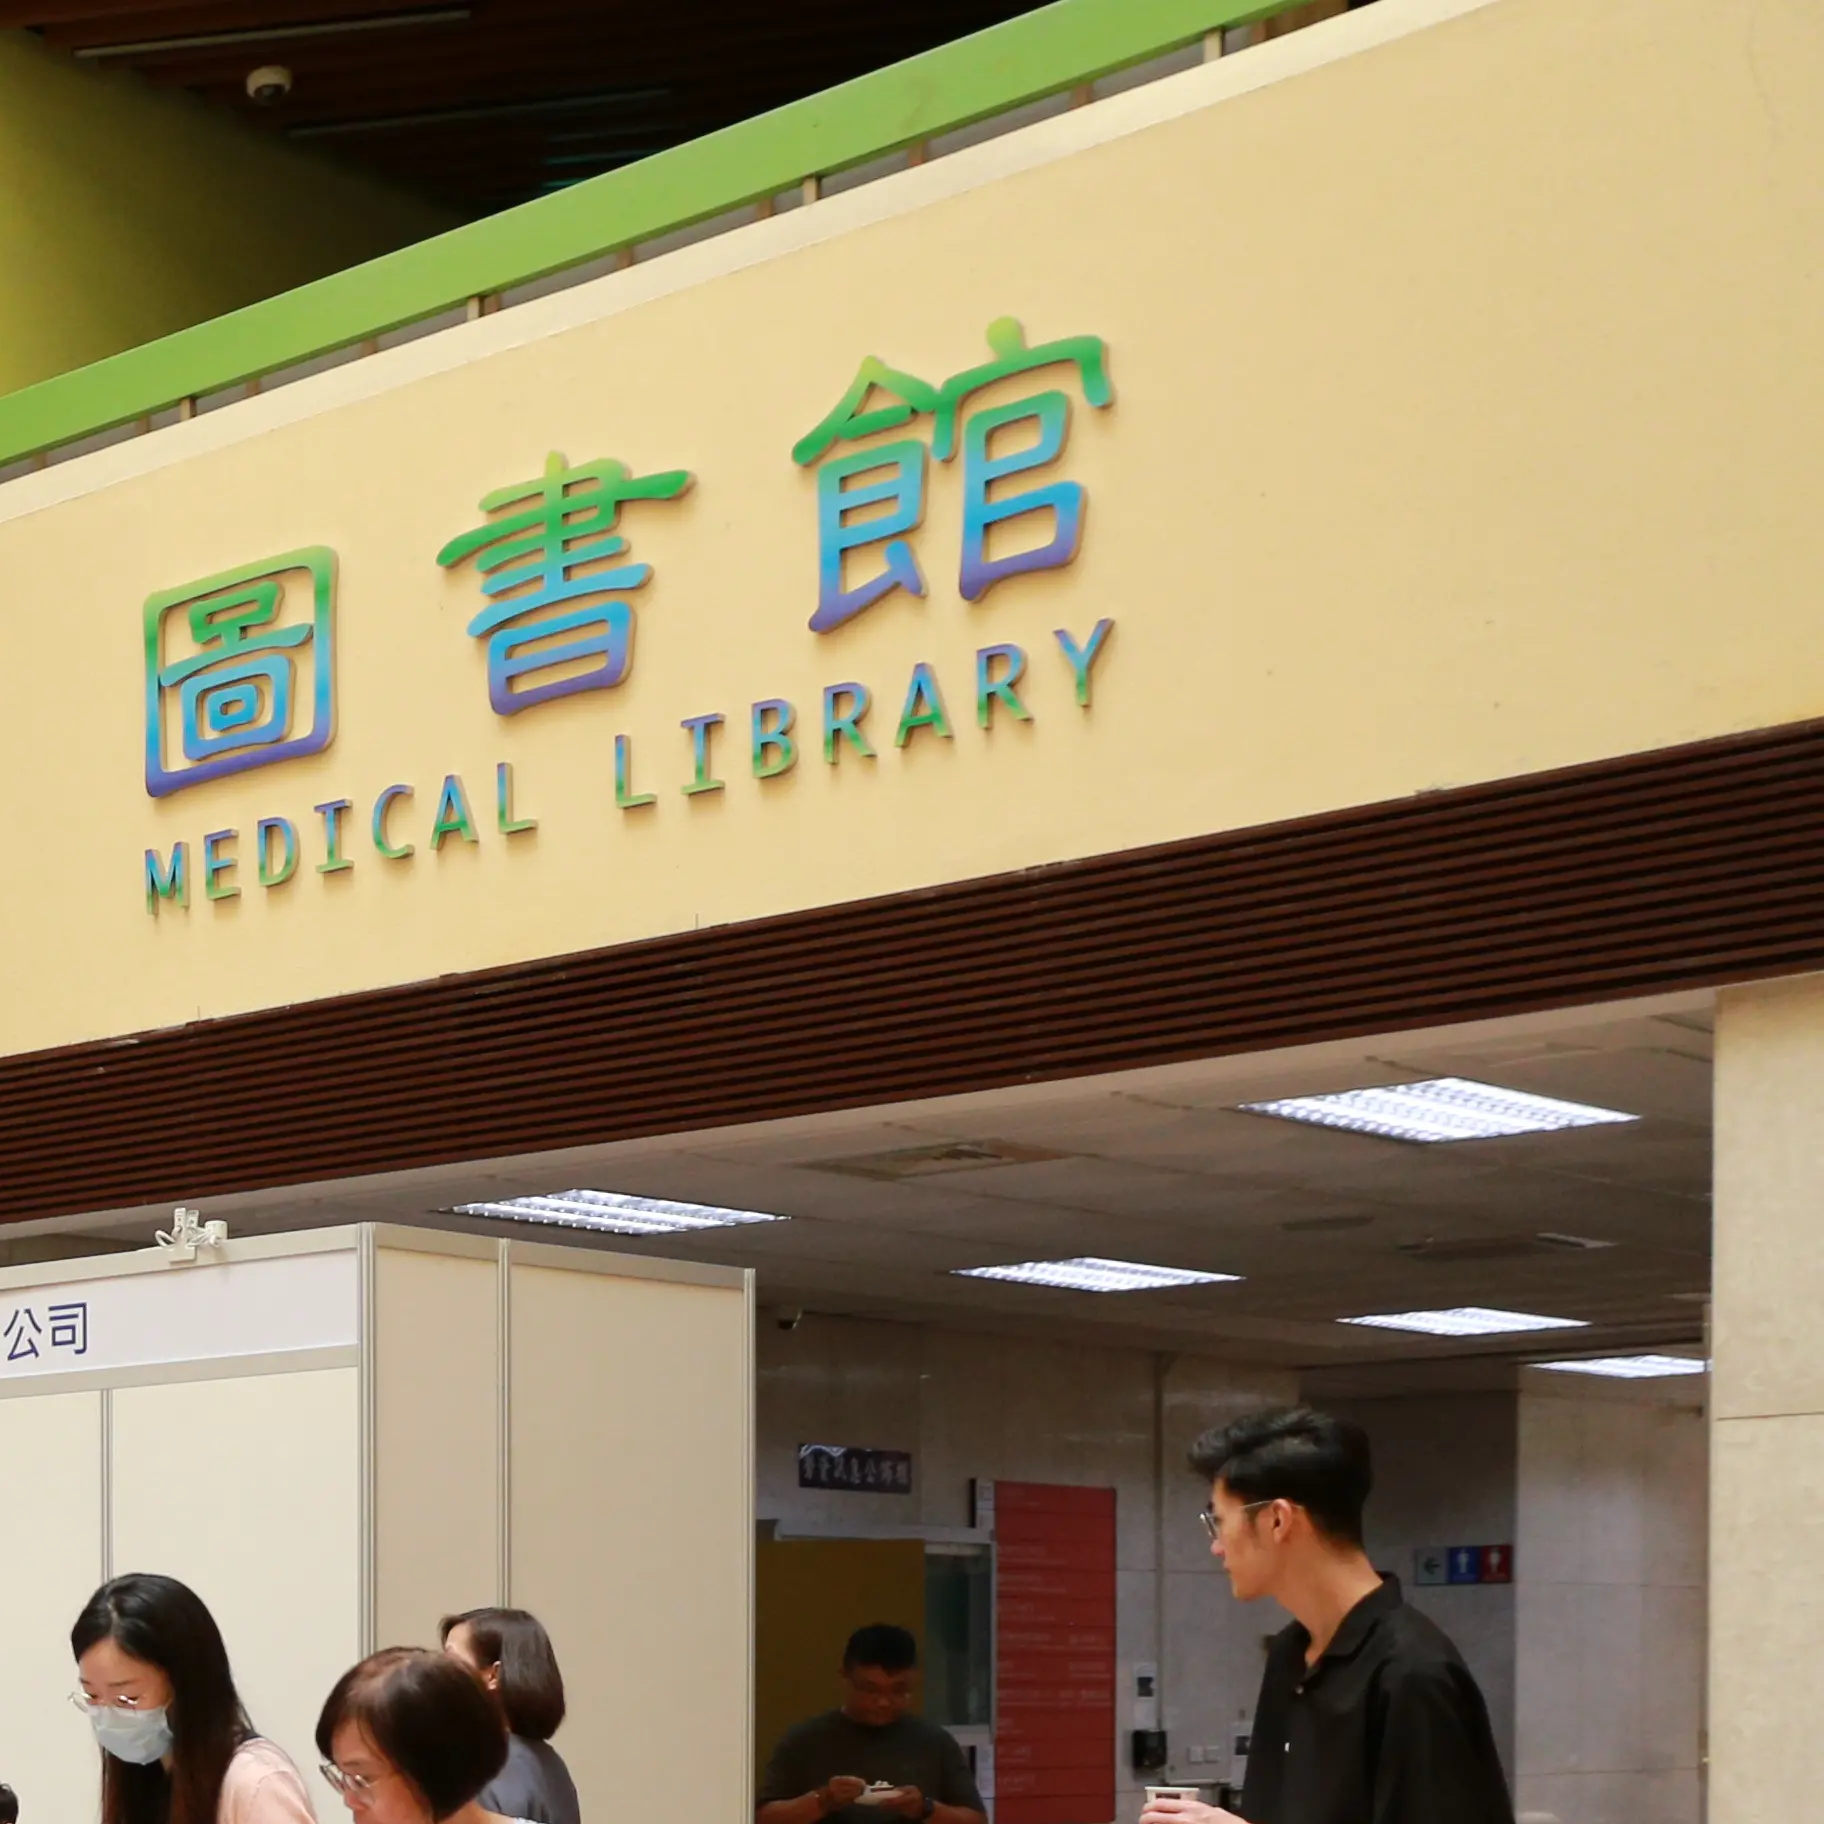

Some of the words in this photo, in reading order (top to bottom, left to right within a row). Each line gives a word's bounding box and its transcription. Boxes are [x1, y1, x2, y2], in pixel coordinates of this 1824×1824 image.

[142, 316, 1116, 800] 圖書館
[143, 761, 538, 916] MEDICAL
[613, 617, 1116, 810] LIBRARY
